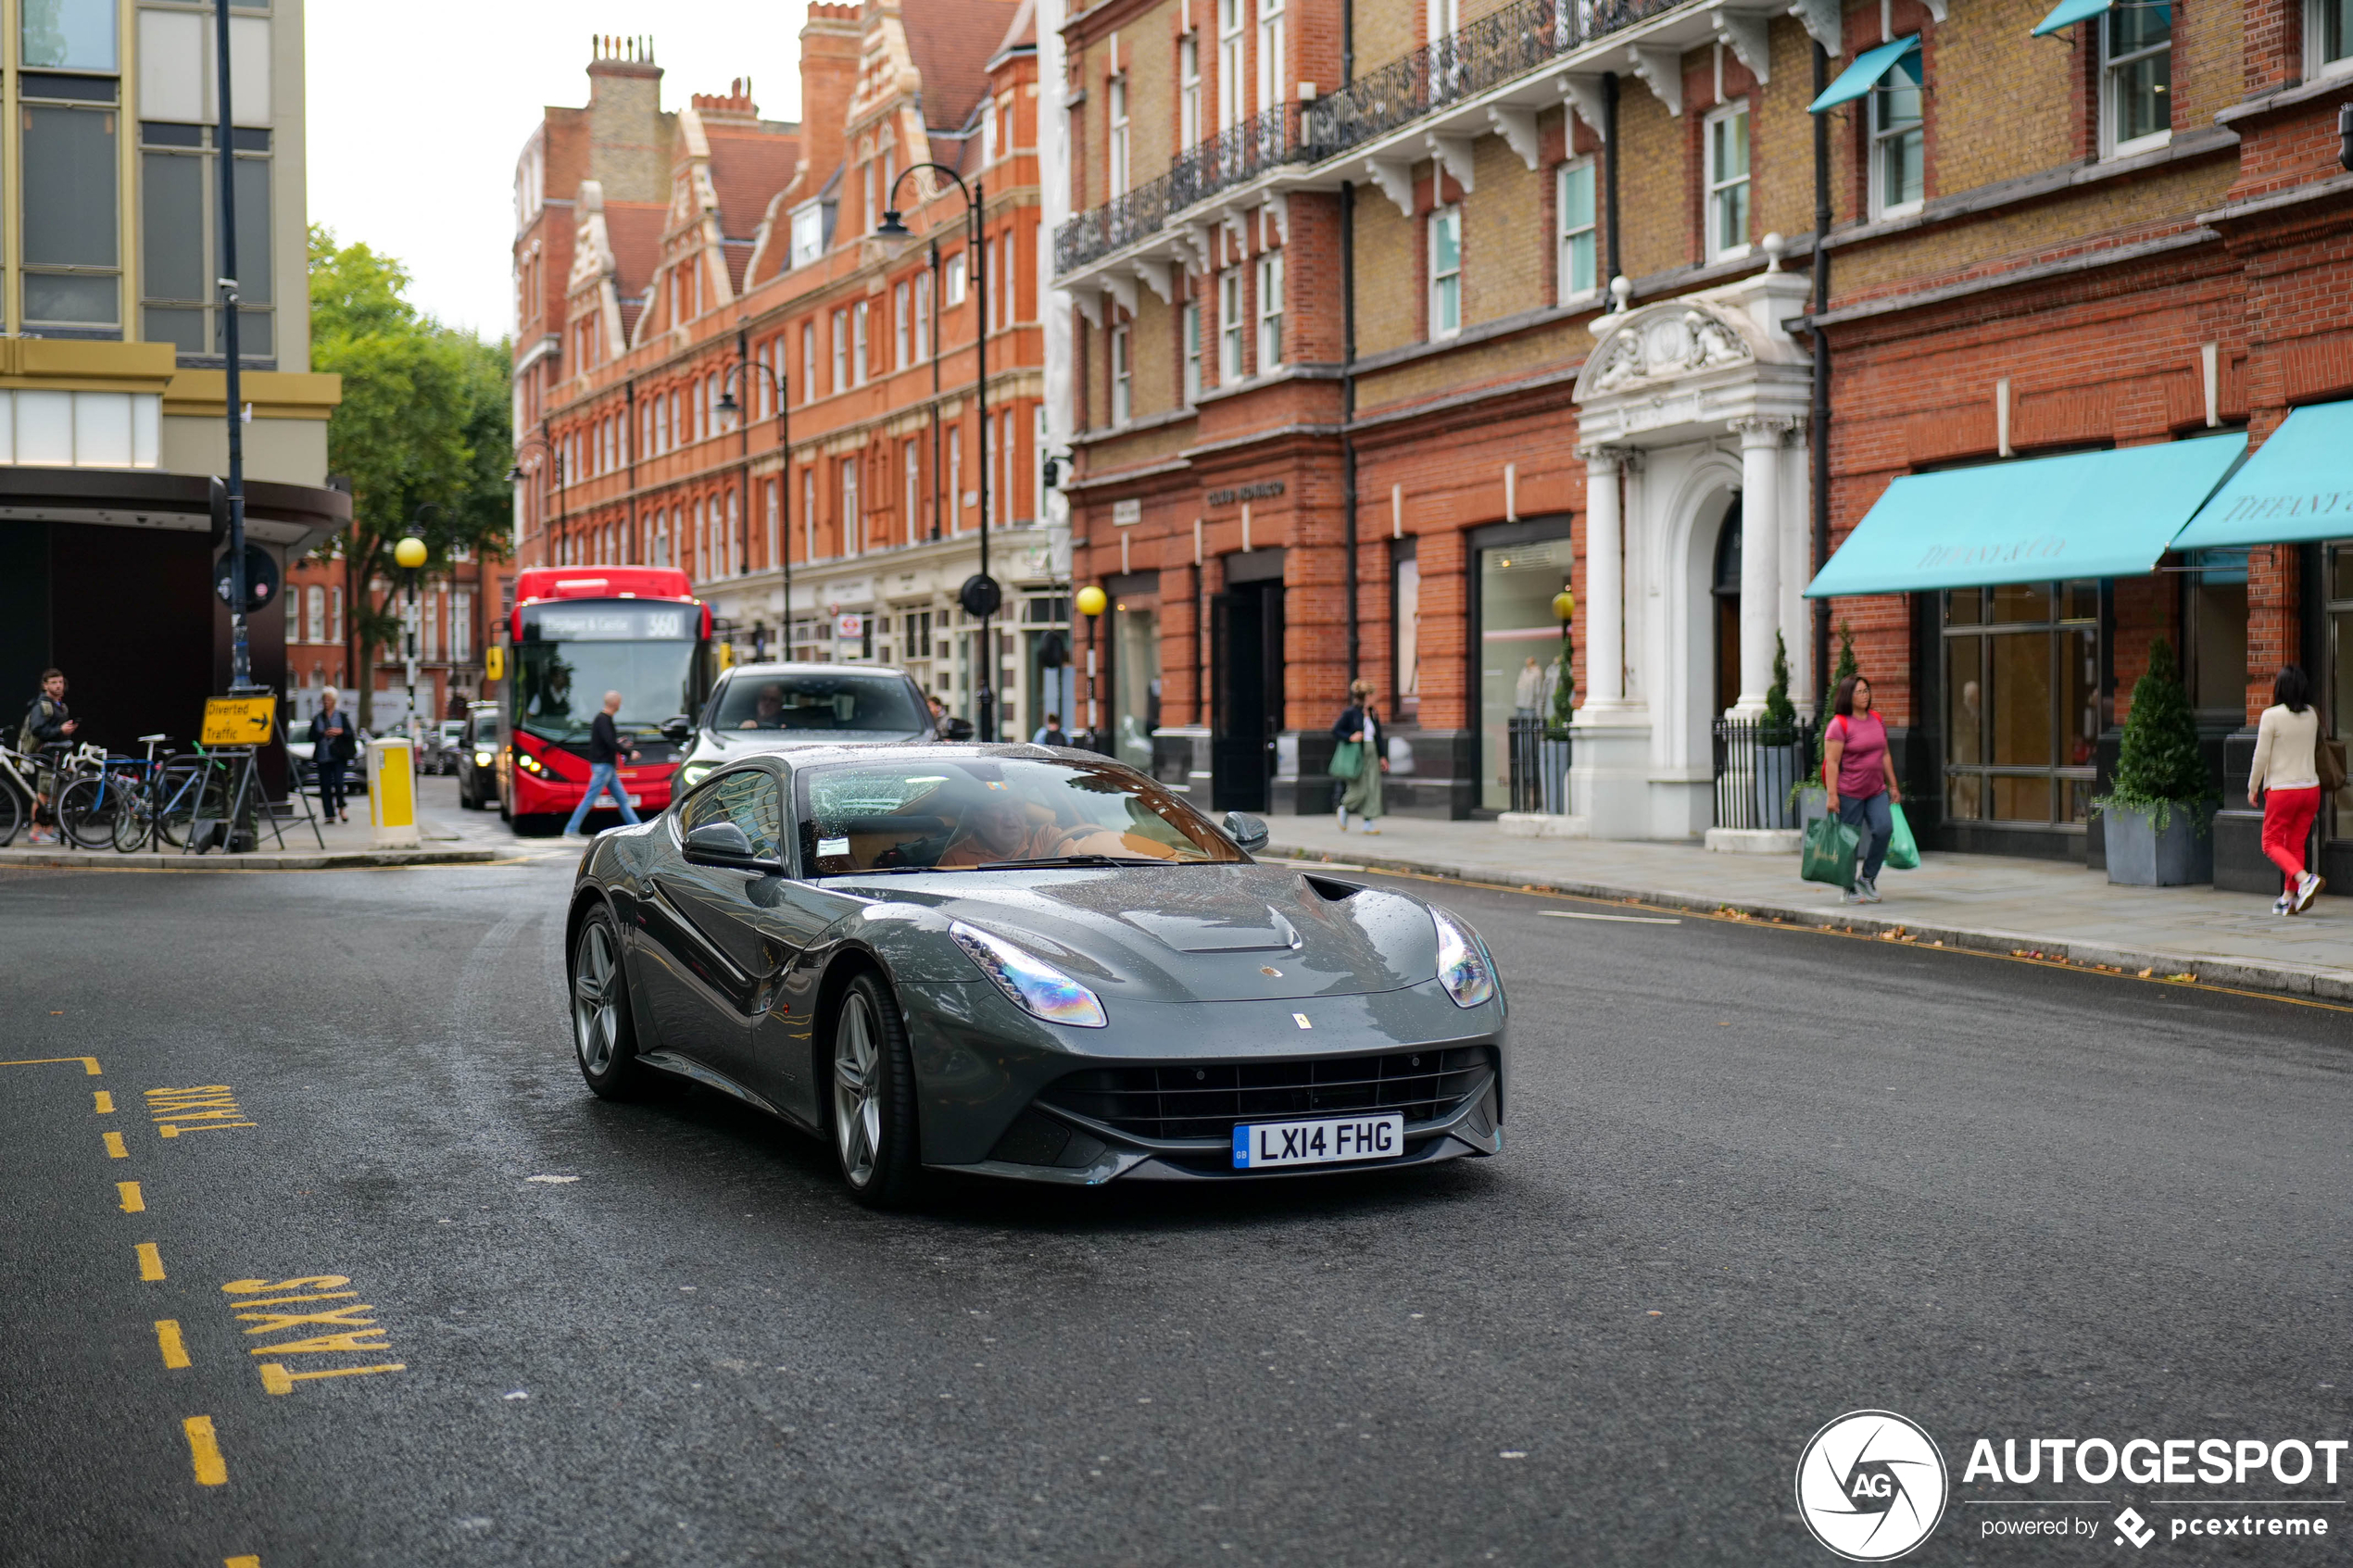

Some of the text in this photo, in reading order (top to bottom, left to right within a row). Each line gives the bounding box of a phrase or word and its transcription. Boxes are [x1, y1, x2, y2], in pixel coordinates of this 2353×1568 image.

[648, 613, 679, 636] 360
[207, 702, 249, 716] Diverted
[207, 727, 238, 740] Traffic
[144, 1085, 258, 1138] TAXIS
[1261, 1122, 1391, 1160] LX14 FHG
[1236, 1150, 1247, 1160] GB
[221, 1275, 407, 1395] TAXIS
